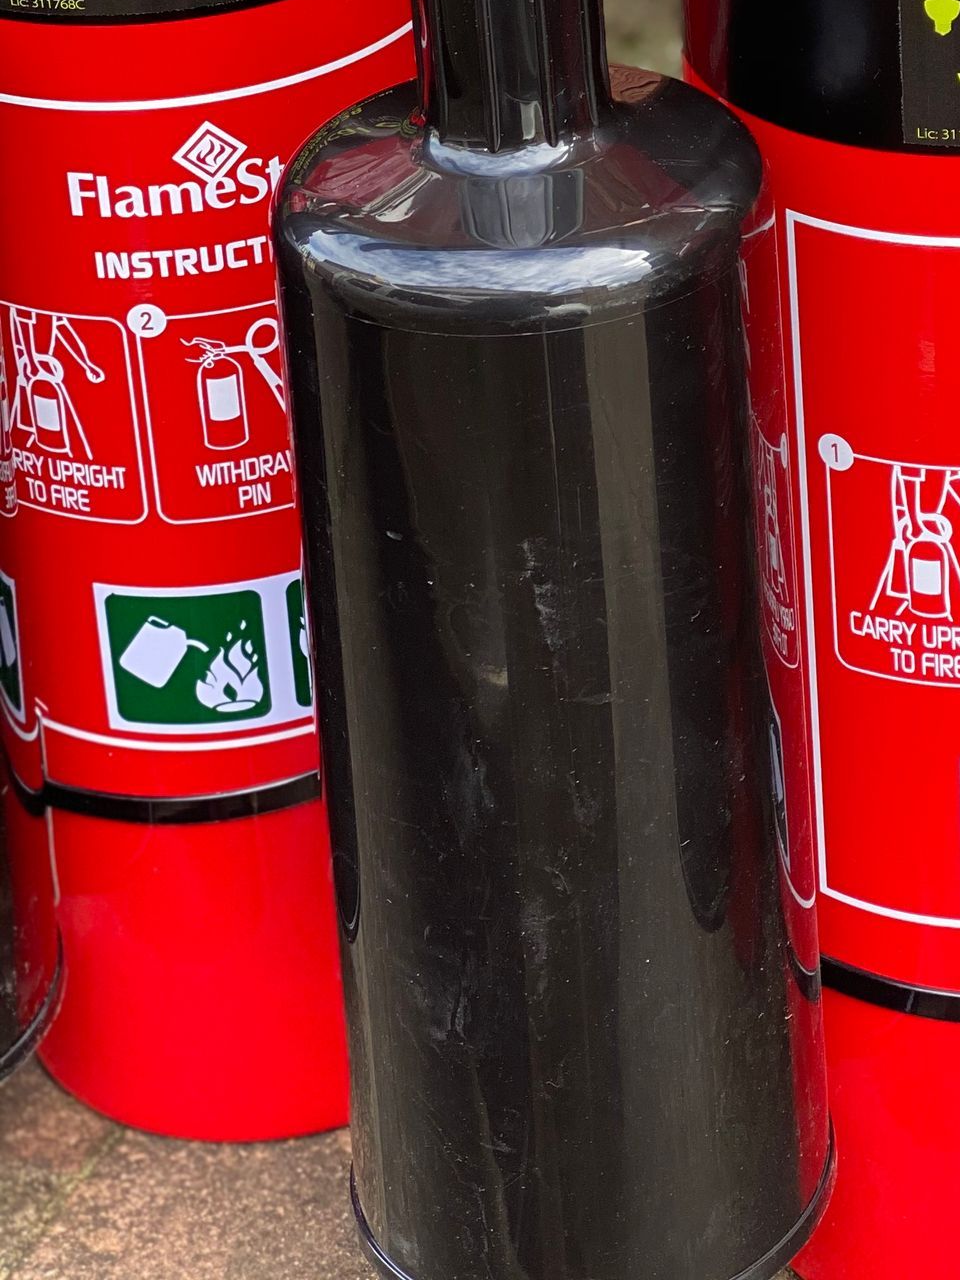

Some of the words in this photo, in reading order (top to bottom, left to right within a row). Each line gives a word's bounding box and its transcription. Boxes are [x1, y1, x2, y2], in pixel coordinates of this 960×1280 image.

[917, 127, 939, 140] Lic:
[66, 155, 285, 218] FlameSt
[140, 312, 155, 331] 2
[829, 443, 840, 463] 1
[12, 447, 44, 477] RRY
[48, 457, 125, 489] UPRIGHT
[25, 476, 47, 503] TO
[51, 484, 91, 512] FIRE
[238, 481, 272, 509] PIN
[850, 610, 916, 644] CARRY
[890, 648, 915, 675] TO
